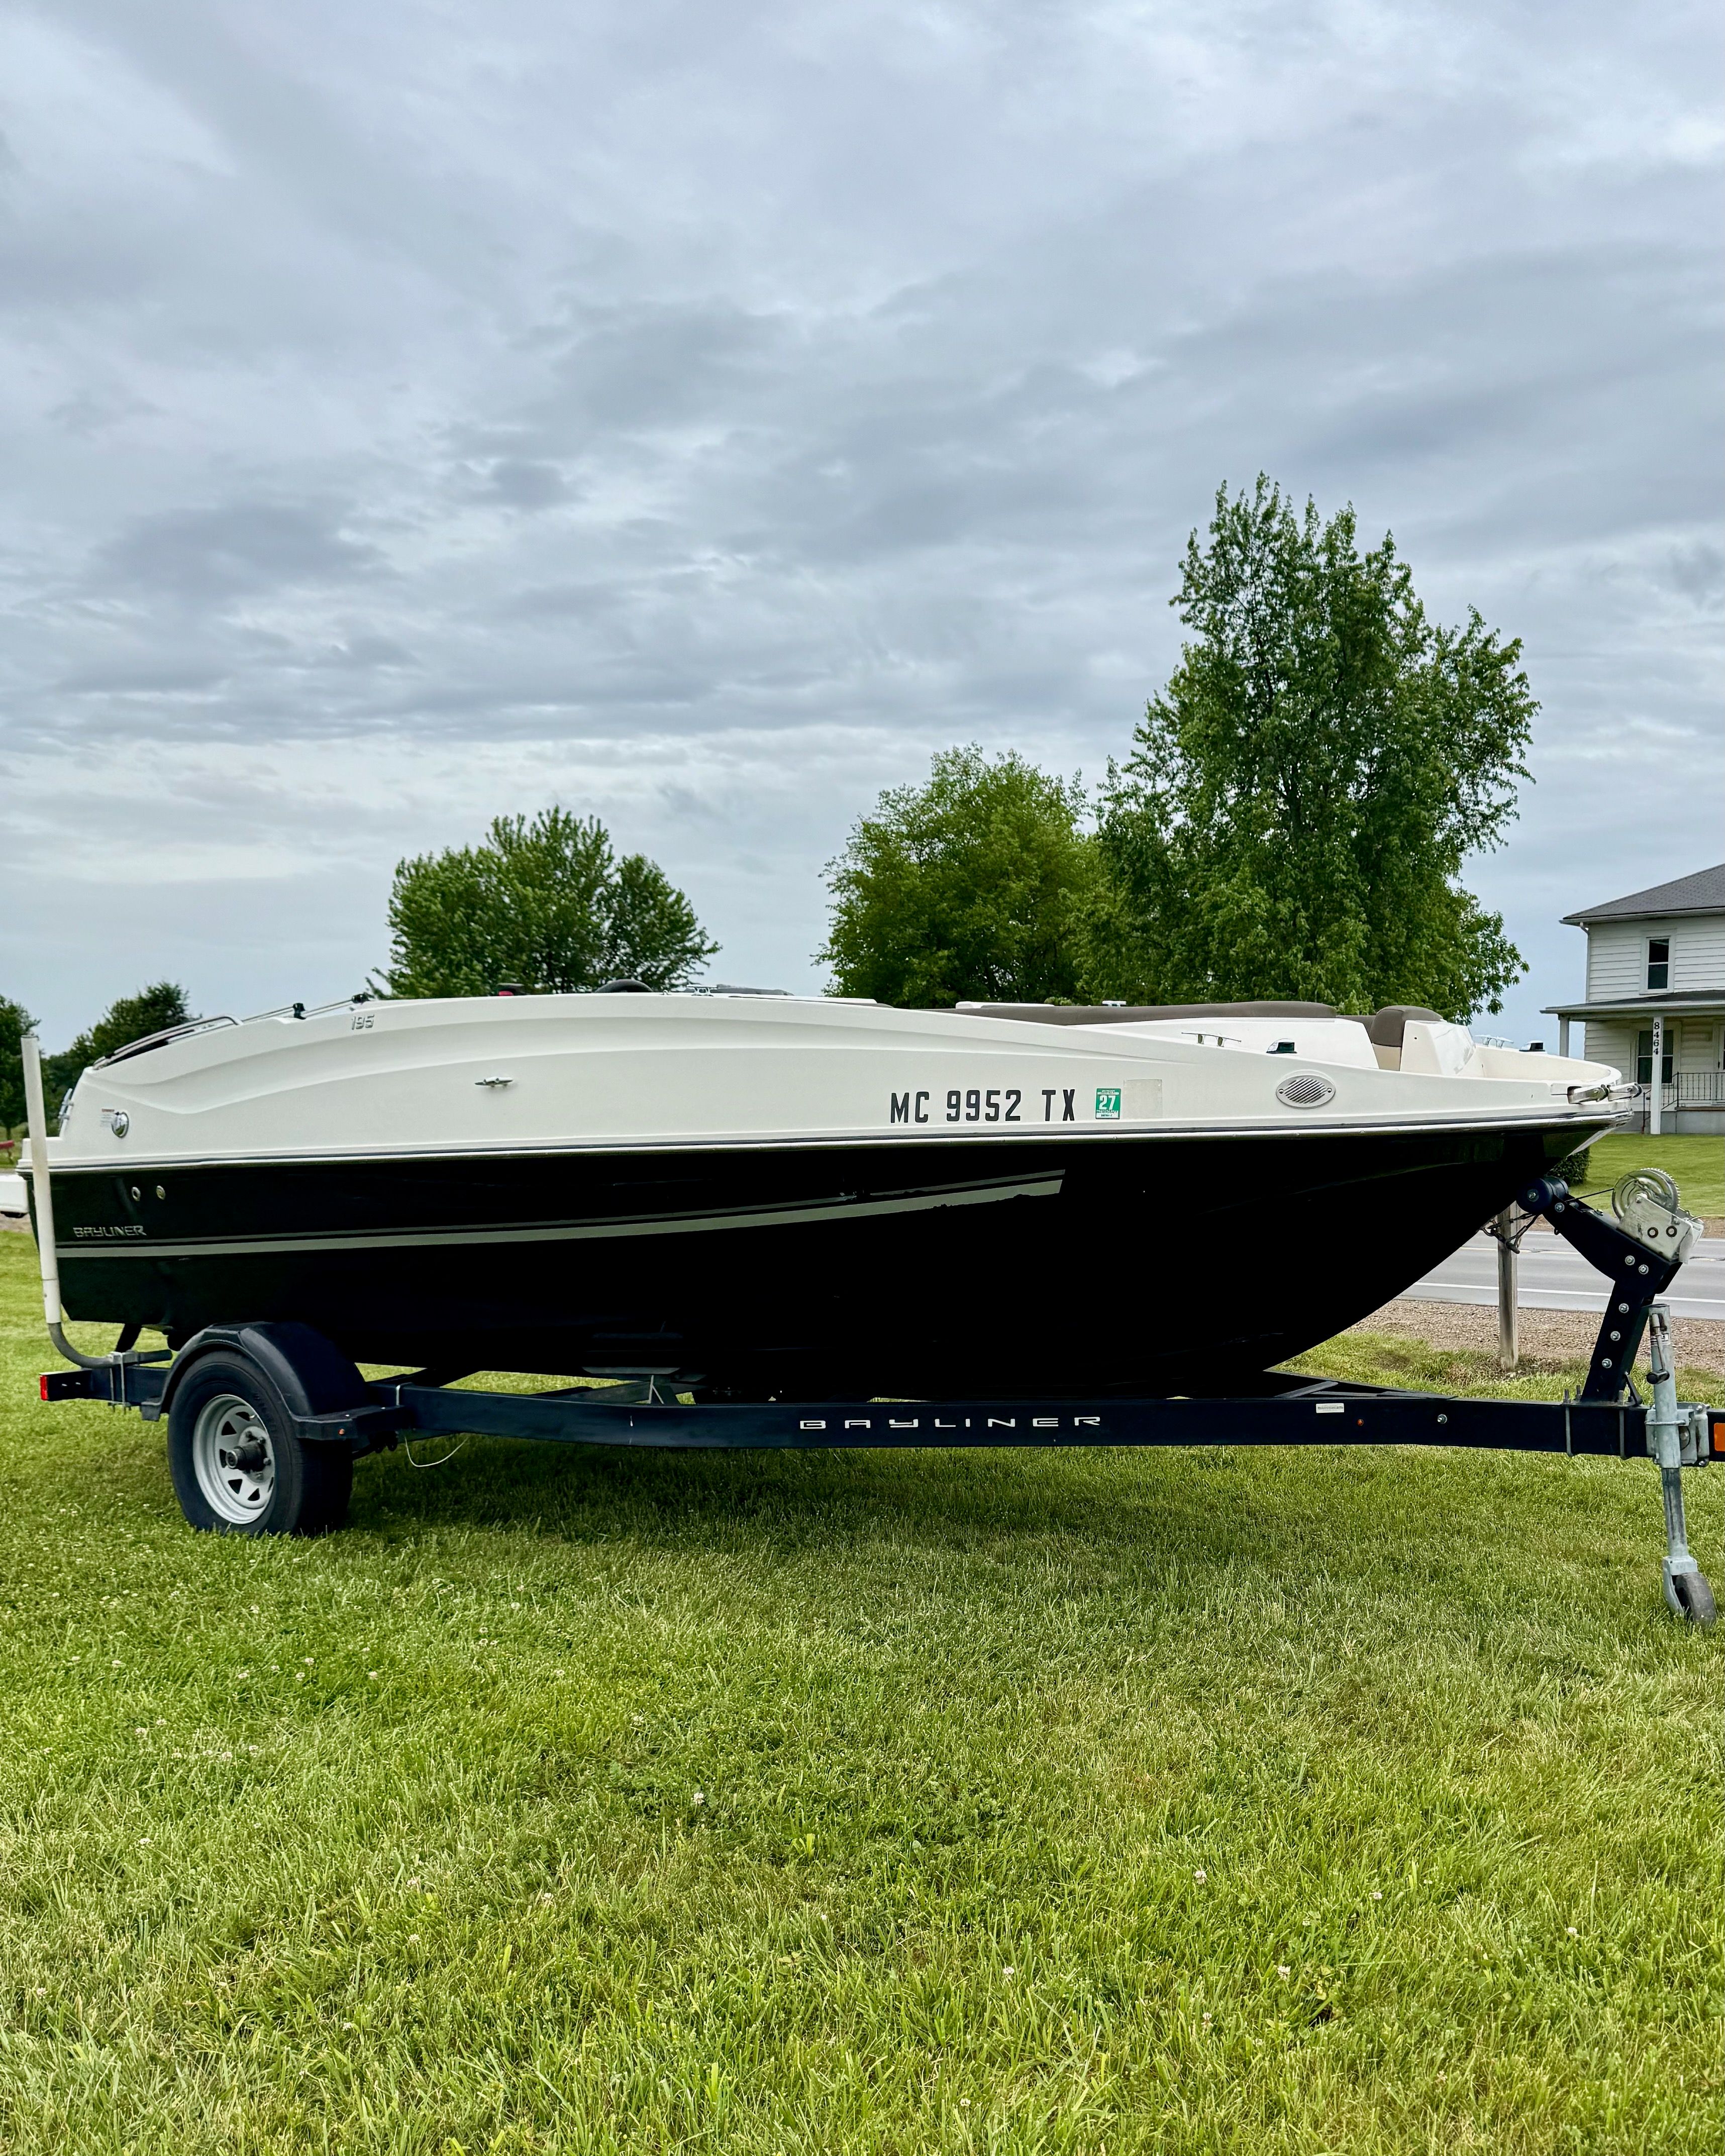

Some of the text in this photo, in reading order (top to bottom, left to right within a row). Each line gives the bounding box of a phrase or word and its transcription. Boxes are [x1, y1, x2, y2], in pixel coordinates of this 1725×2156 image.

[351, 1014, 375, 1030] 195
[890, 1089, 1075, 1123] MC 9952 TX
[1099, 1095, 1116, 1110] 27
[73, 1225, 147, 1237] BAYLINER
[799, 1416, 1101, 1429] BAYLINER
